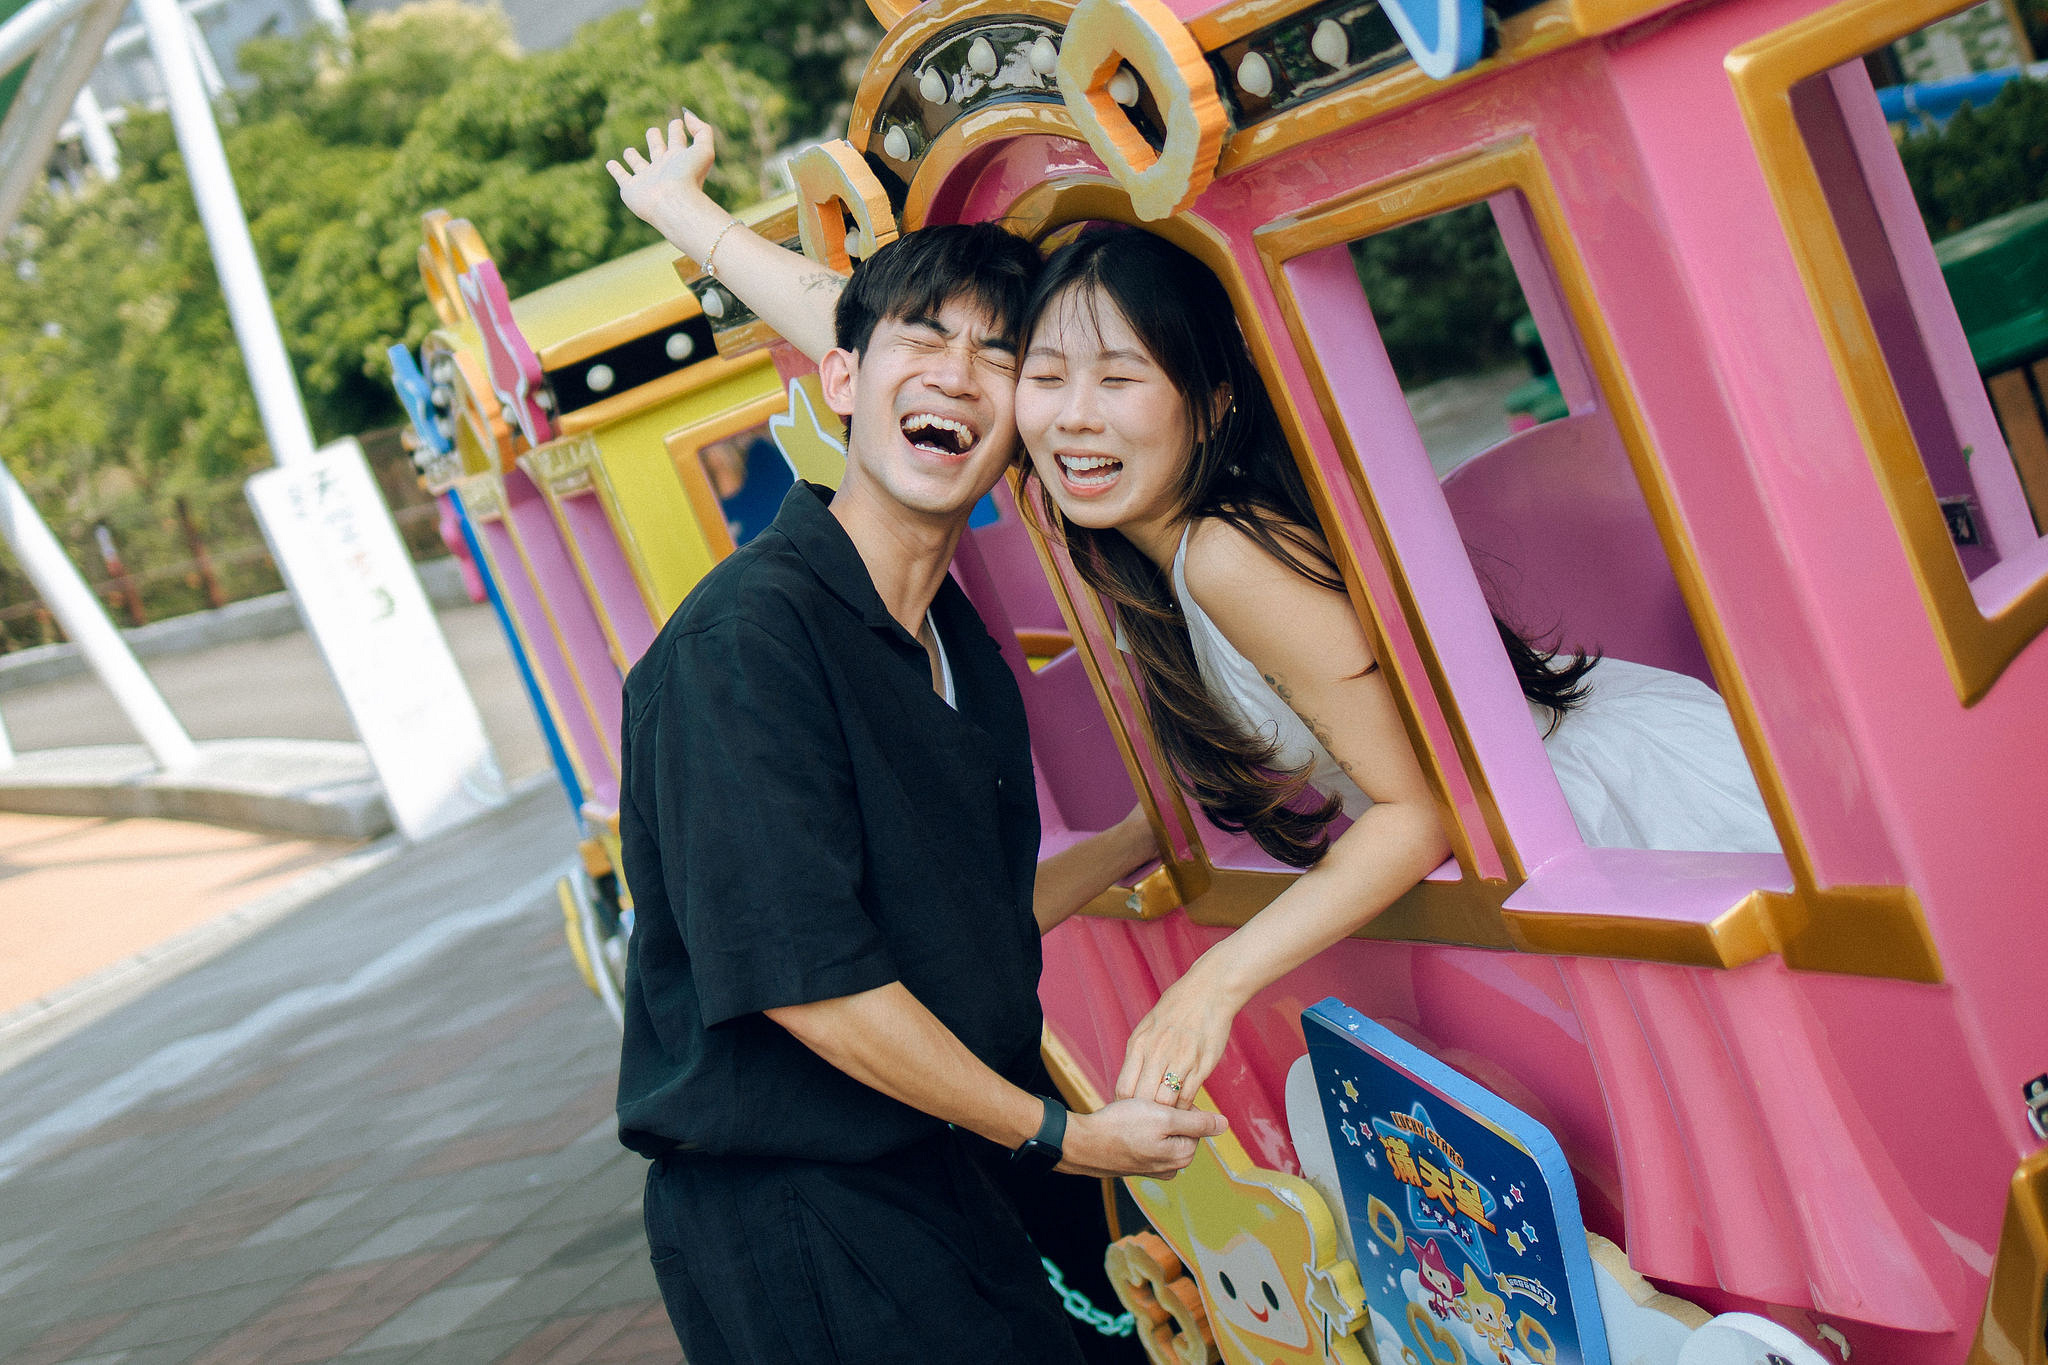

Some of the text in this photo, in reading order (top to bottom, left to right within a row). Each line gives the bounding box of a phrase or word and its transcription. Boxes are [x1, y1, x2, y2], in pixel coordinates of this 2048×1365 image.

[1391, 1112, 1463, 1168] LUCKY STARS
[1378, 1134, 1497, 1235] 滿天星
